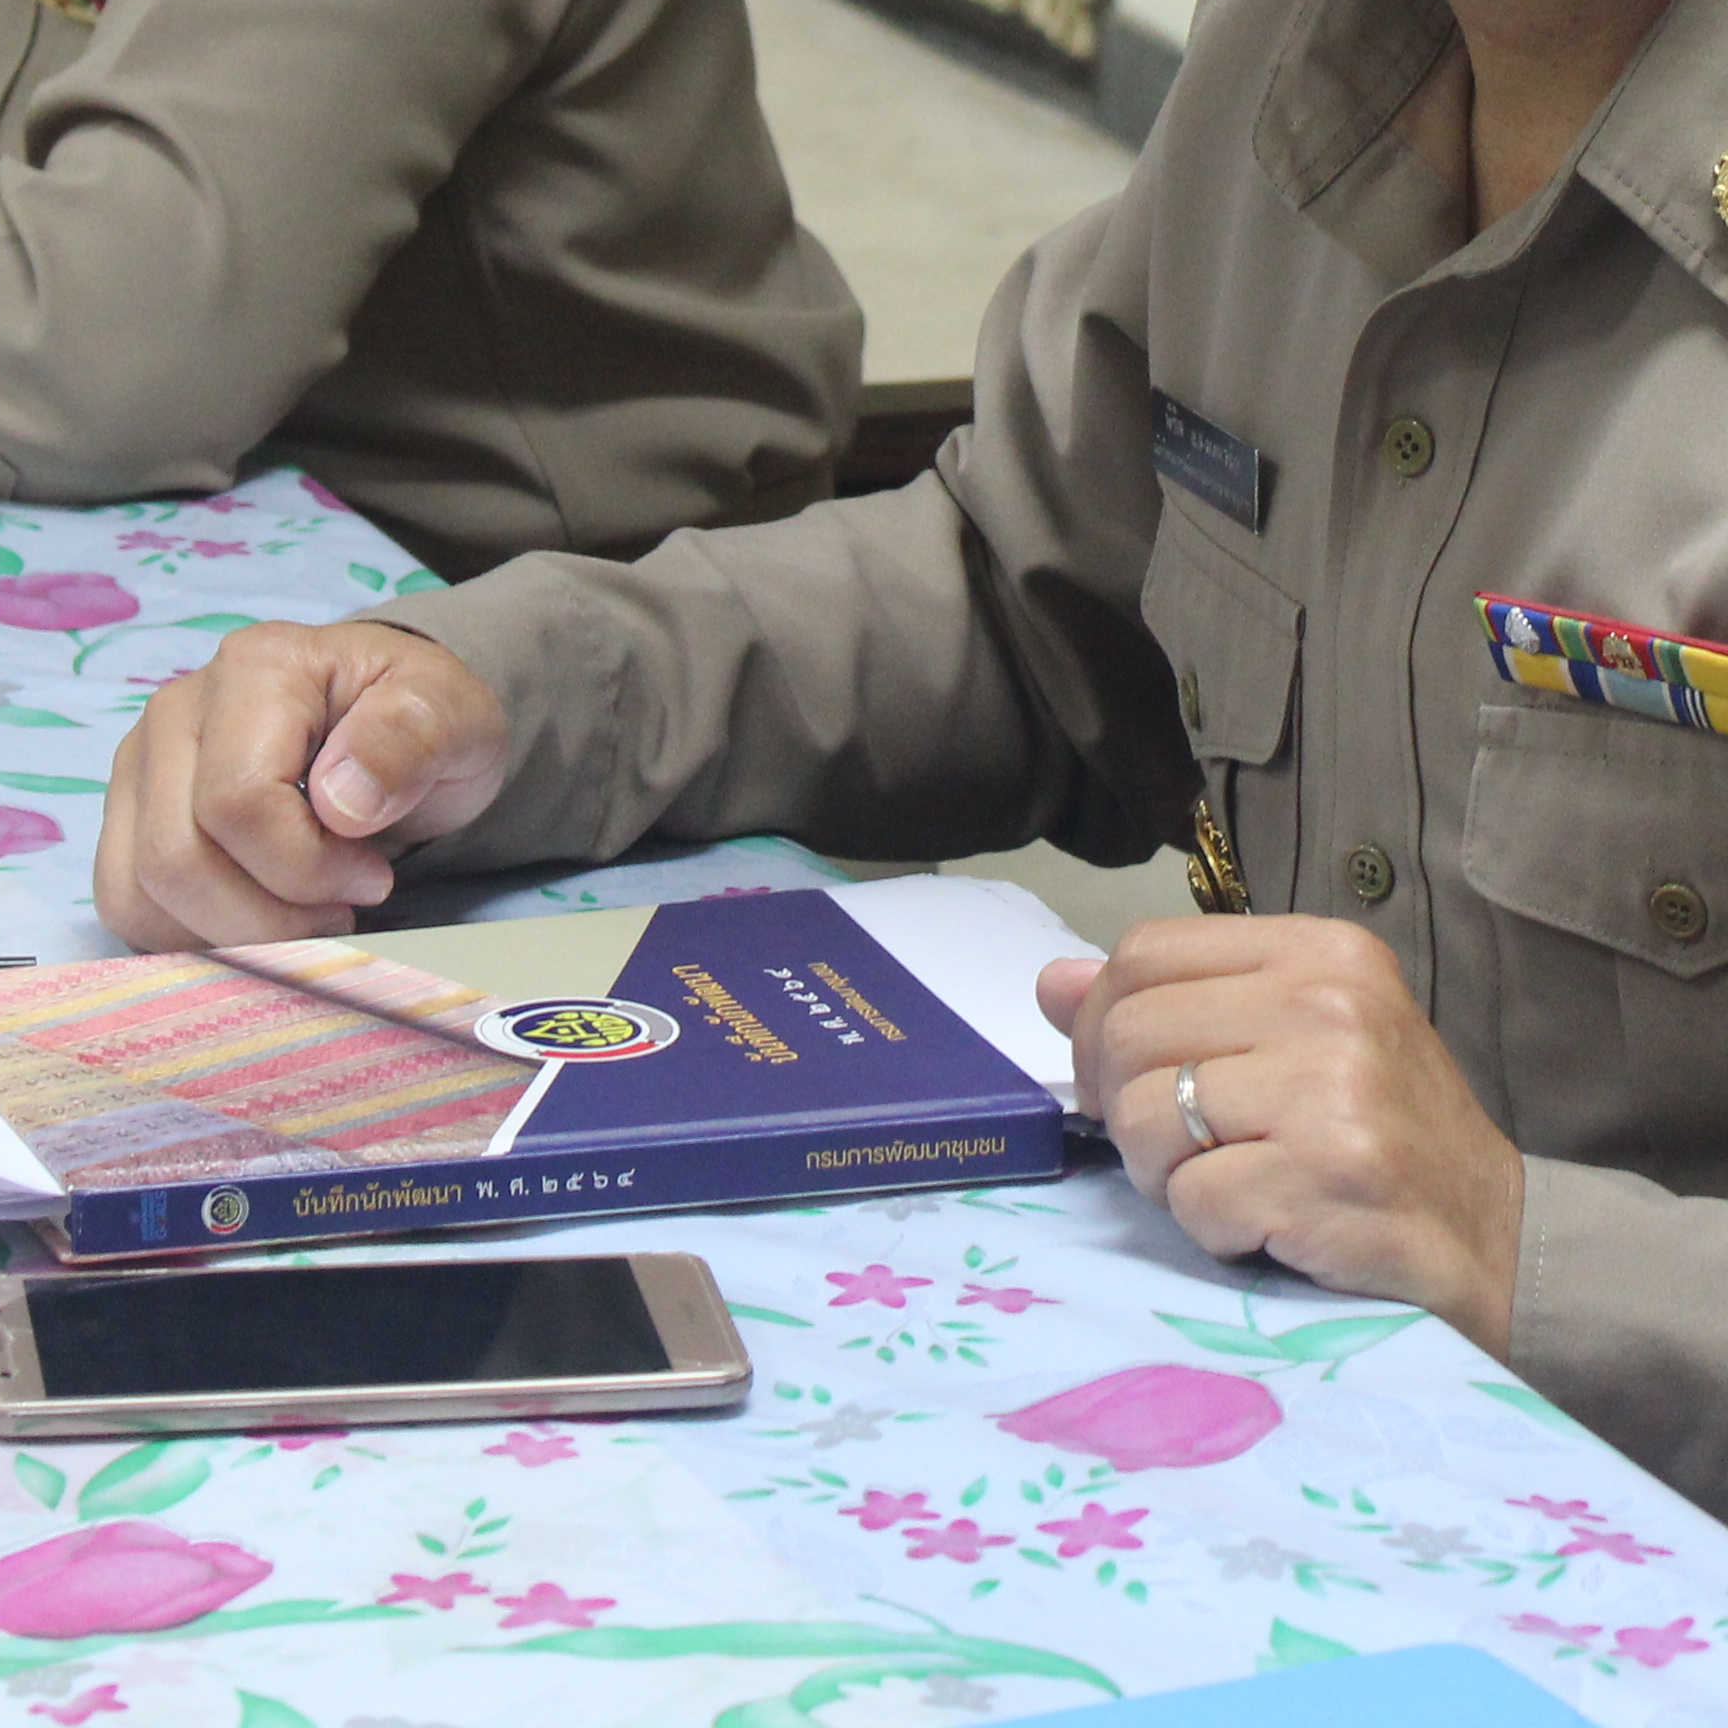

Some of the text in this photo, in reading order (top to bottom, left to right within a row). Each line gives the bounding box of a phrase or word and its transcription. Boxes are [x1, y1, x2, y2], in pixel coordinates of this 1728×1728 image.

[806, 1136, 1007, 1170] กรมการพัฒนาชุมชน
[293, 1180, 463, 1217] บันทึกนักพัฒนา
